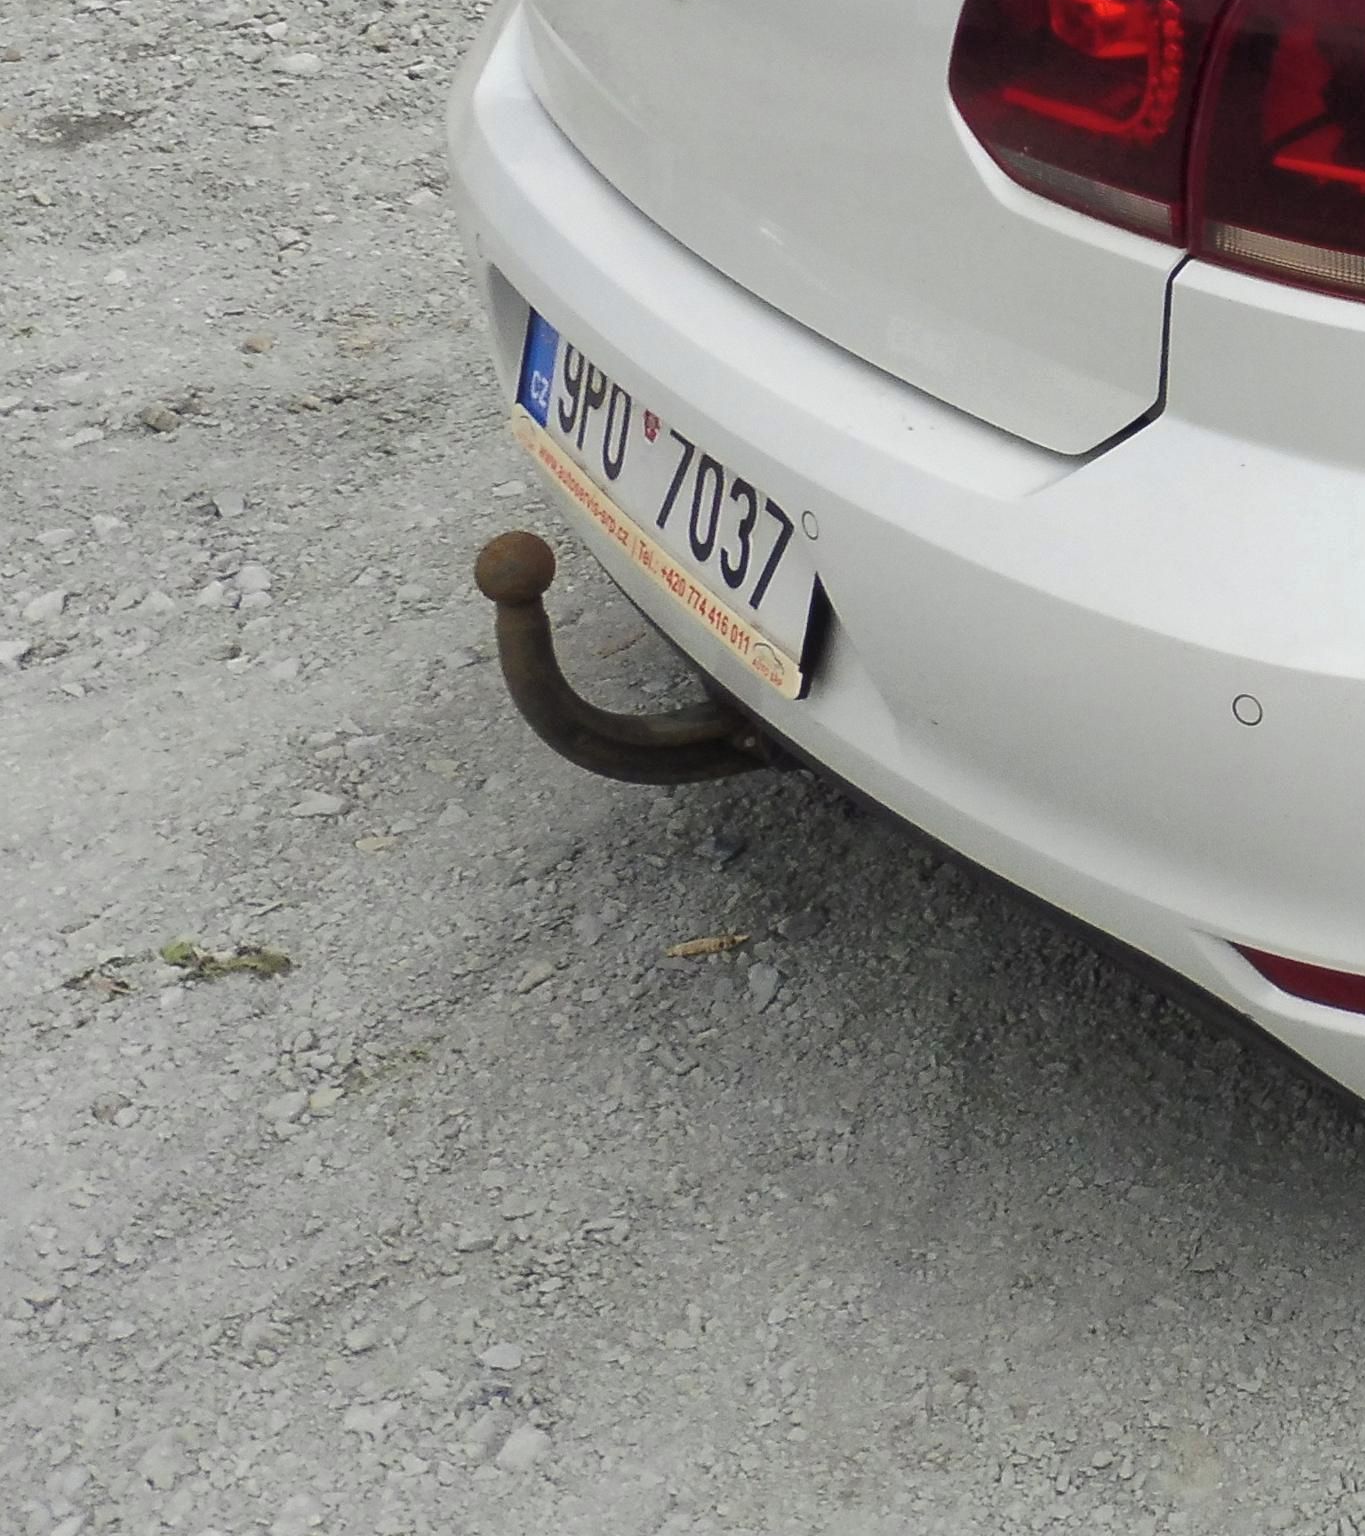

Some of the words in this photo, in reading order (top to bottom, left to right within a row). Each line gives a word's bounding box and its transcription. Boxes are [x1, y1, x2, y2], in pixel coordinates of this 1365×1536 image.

[530, 370, 550, 409] CZ
[656, 428, 795, 611] 7037
[661, 567, 687, 598] +420
[687, 585, 707, 617] 774
[708, 606, 729, 636] 416
[730, 623, 751, 655] 011
